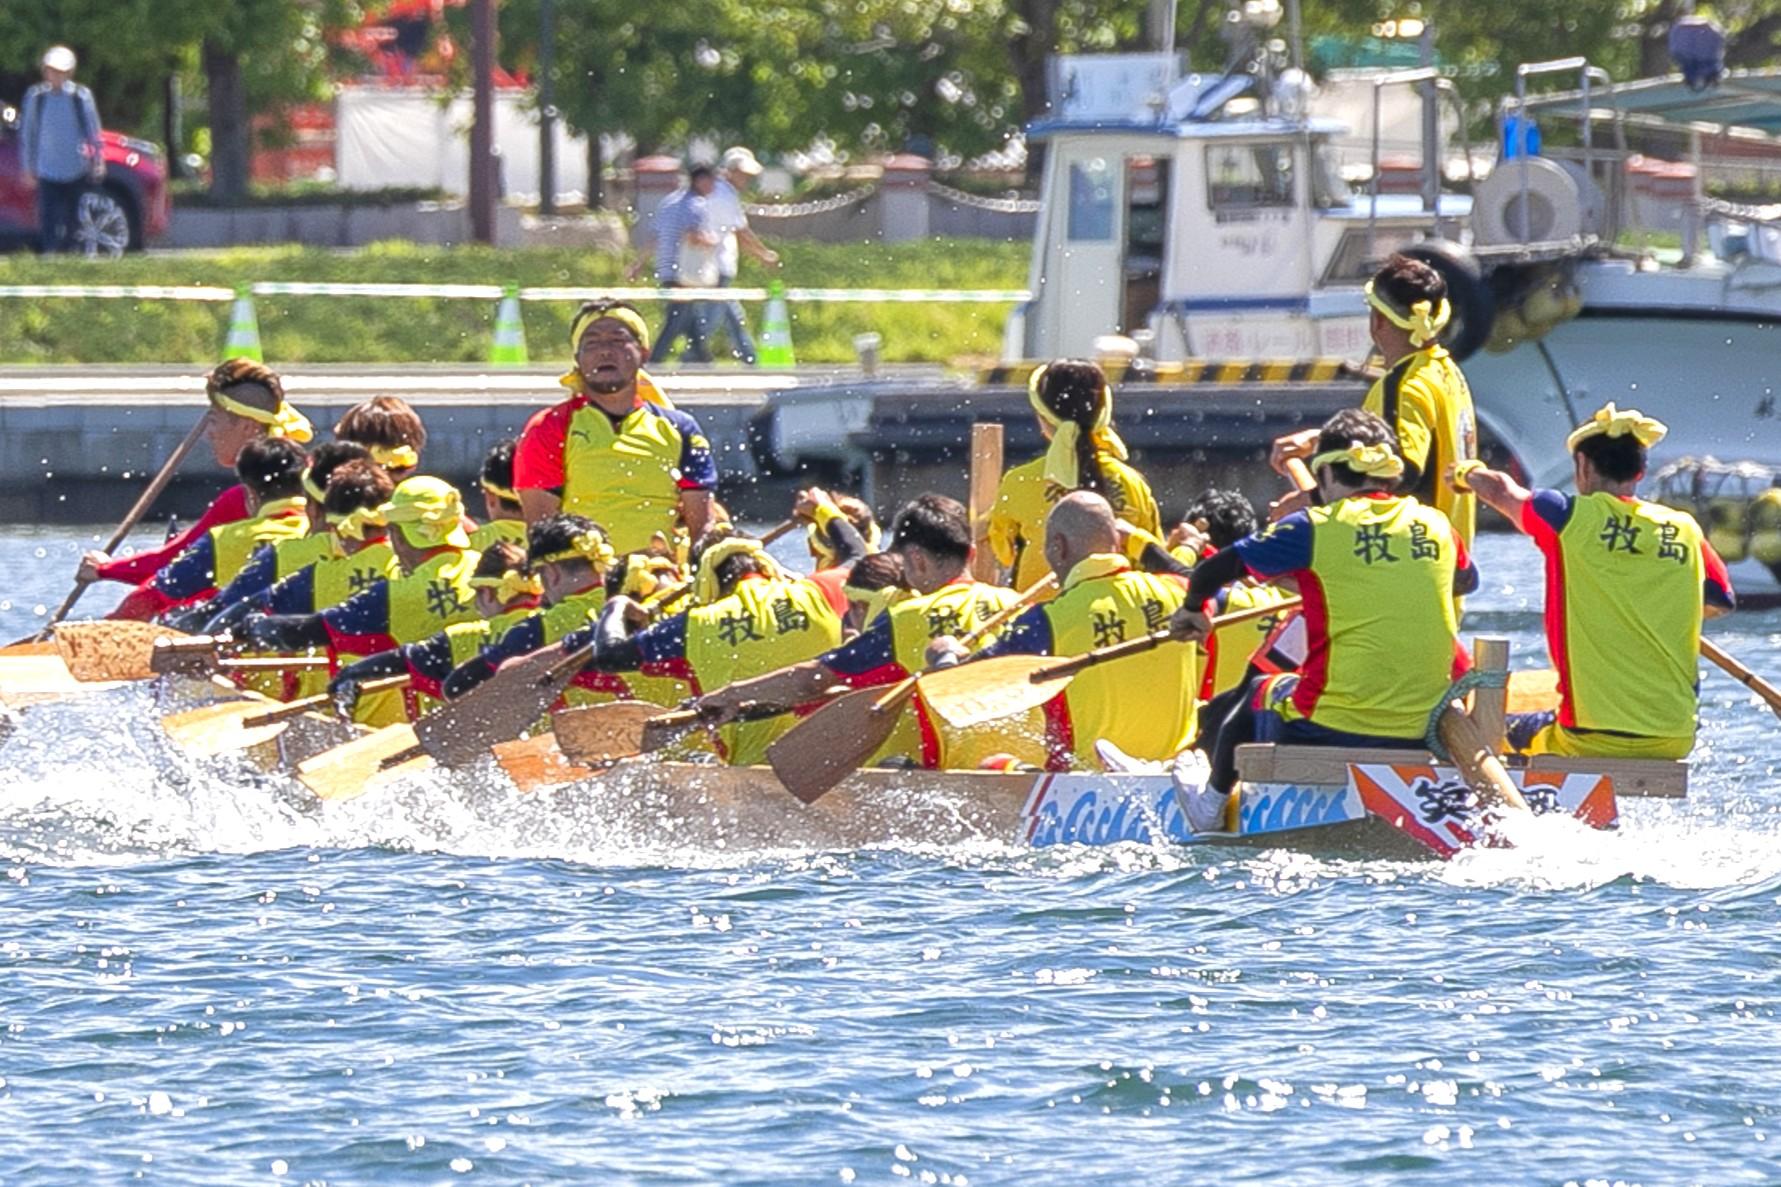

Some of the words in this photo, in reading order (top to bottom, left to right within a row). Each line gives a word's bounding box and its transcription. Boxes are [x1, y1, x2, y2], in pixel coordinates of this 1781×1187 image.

[1353, 520, 1440, 565] 牧島
[1601, 515, 1689, 565] 牧島
[718, 597, 811, 647] 牧島
